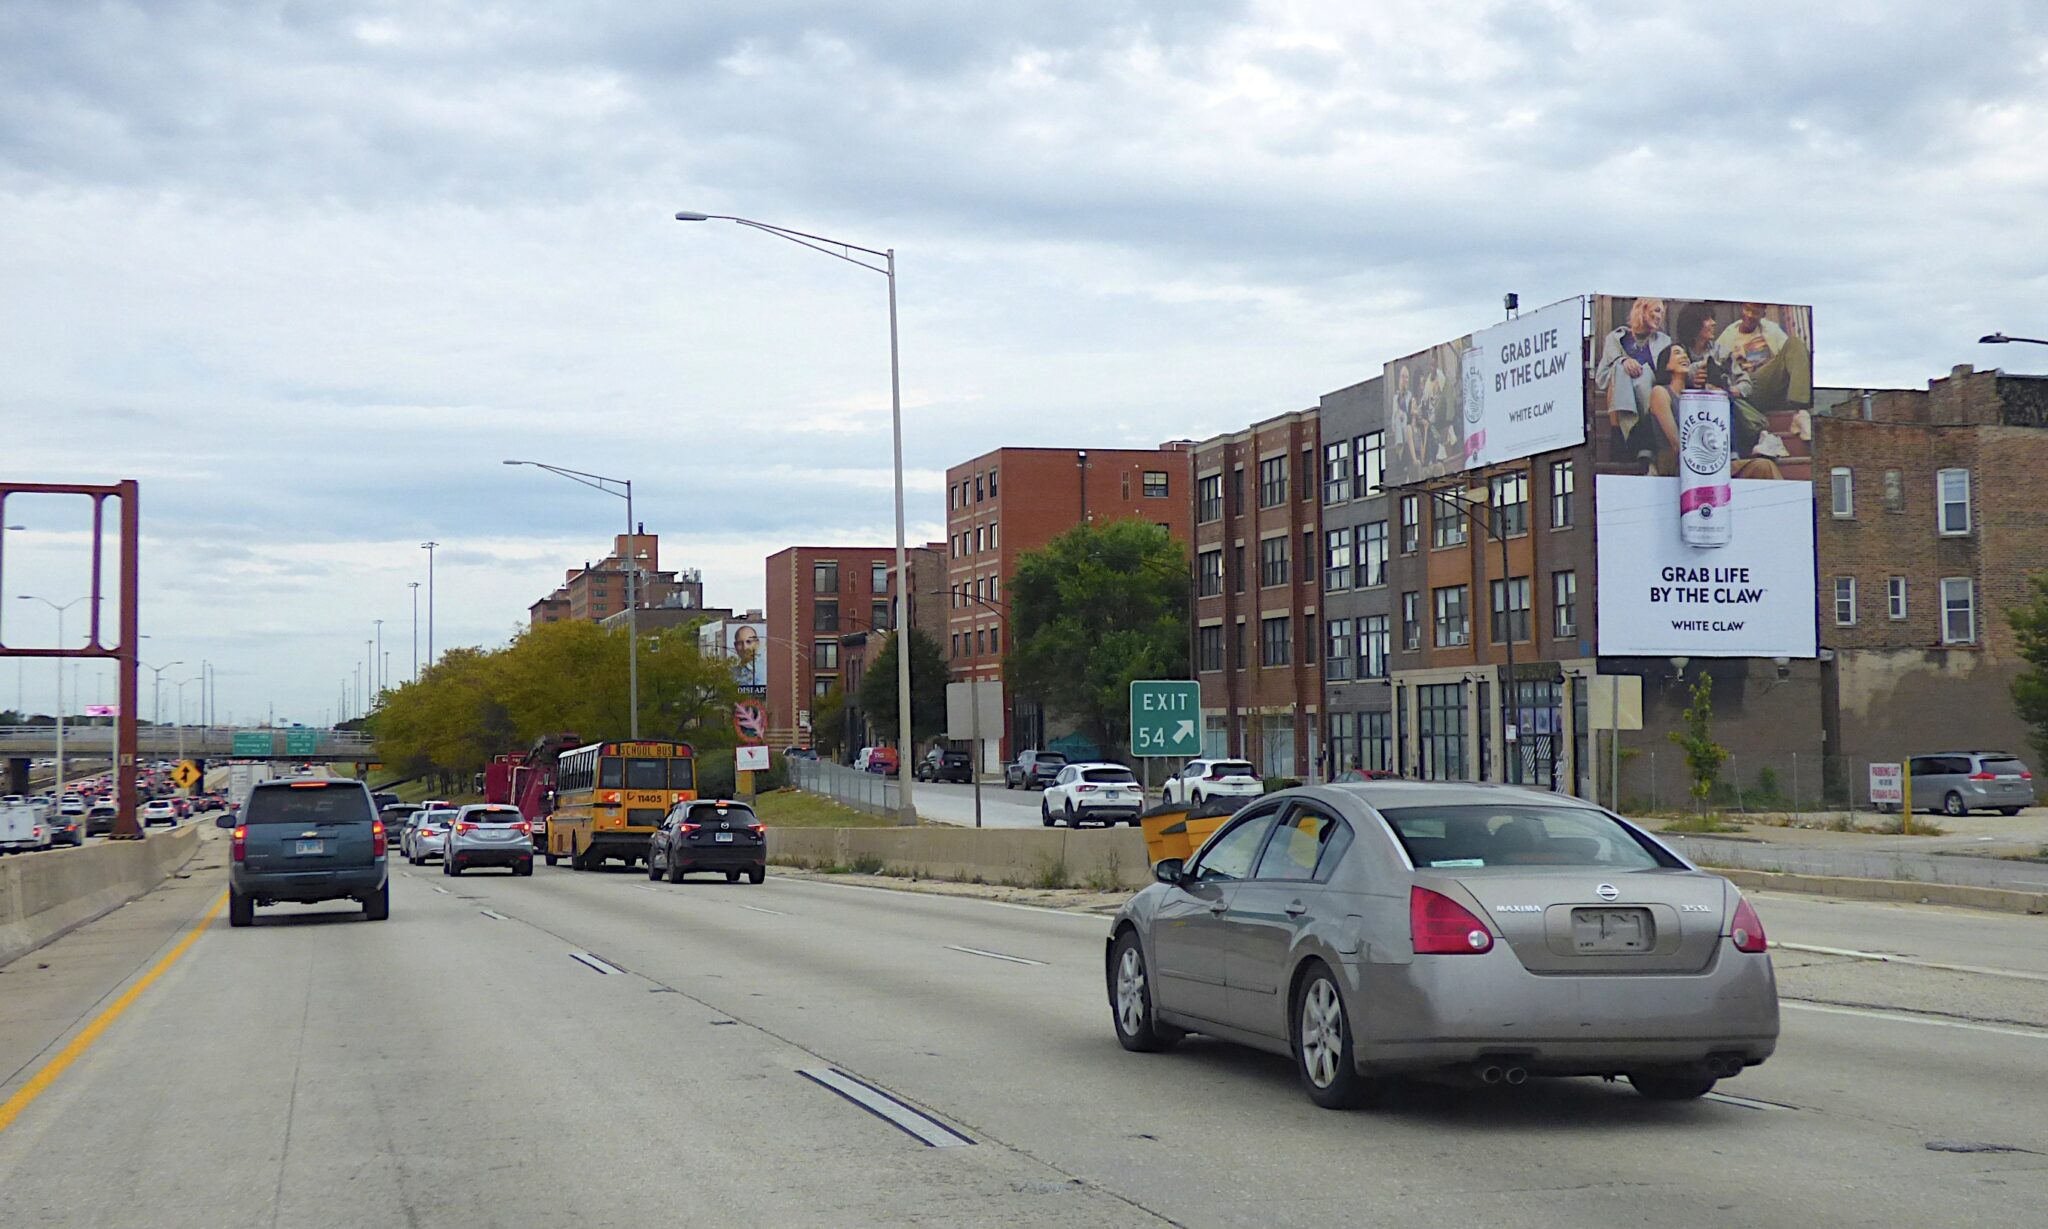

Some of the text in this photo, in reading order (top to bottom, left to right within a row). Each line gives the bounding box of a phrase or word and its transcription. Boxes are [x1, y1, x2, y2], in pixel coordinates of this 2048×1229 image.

[1501, 329, 1558, 364] GRAB LIFE
[1495, 353, 1567, 392] BY THE CLAW
[1509, 400, 1554, 423] WHITE CLAW
[1681, 411, 1727, 452] WHITE CLAW
[1687, 457, 1707, 472] HARD
[1661, 567, 1750, 583] GRAB LIFE
[1650, 587, 1763, 604] BY THE CLAW
[1671, 620, 1744, 631] WHITE CLAW
[1143, 693, 1188, 710] EXIT
[1139, 727, 1165, 748] 54
[621, 745, 672, 756] SCHOOL BUS
[638, 795, 662, 803] 11405
